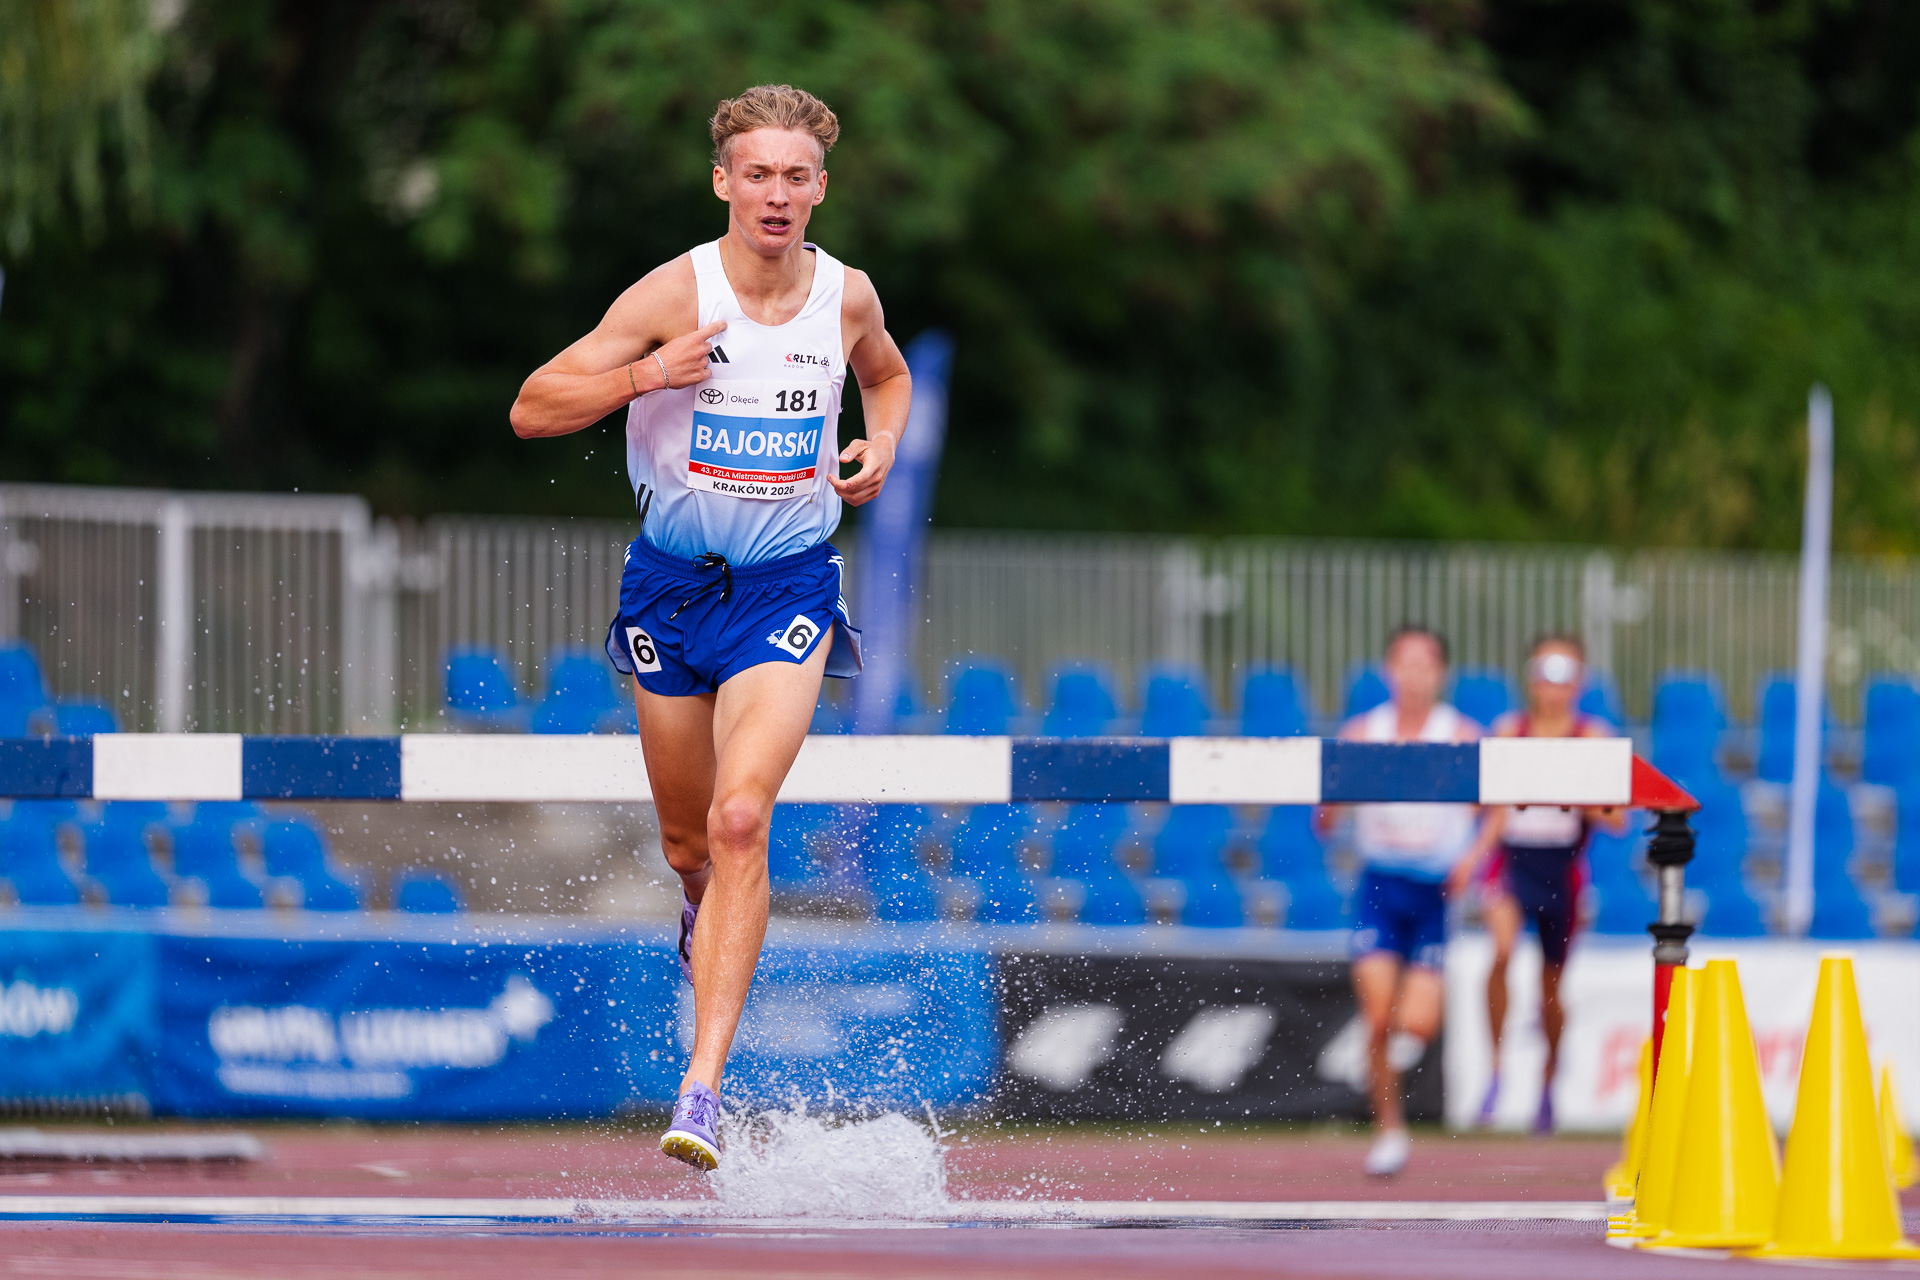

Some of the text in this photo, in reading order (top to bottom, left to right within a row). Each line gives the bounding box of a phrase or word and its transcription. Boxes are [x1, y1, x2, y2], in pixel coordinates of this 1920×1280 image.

[793, 353, 818, 365] RLTL
[730, 396, 759, 404] Okęcie
[775, 389, 817, 412] 181
[695, 424, 818, 458] BAJORSKI
[700, 466, 807, 482] 43. PZLA Mistrzostwa Polski U23
[713, 480, 795, 496] KRAKÓW 2026
[787, 624, 813, 650] 6
[632, 634, 656, 664] 6
